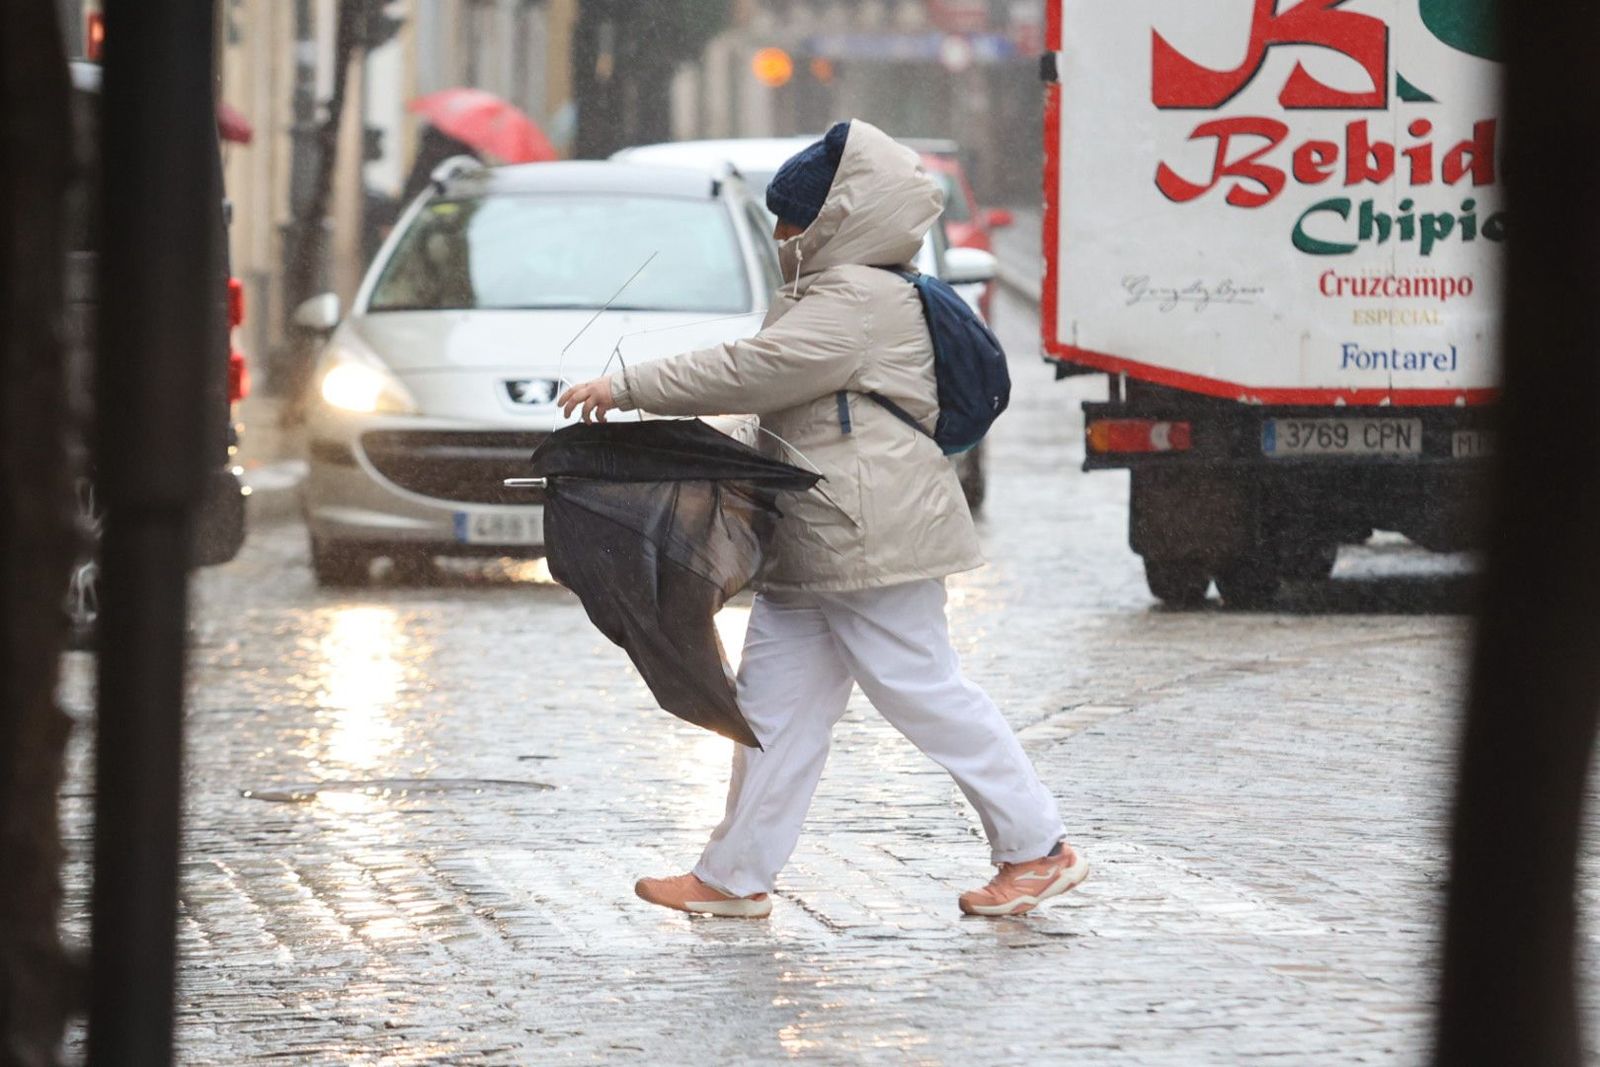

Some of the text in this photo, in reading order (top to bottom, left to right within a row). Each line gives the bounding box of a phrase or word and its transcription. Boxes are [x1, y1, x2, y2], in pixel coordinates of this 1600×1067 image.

[1155, 116, 1497, 208] Bebid
[1319, 268, 1474, 302] Cruzcampo
[1352, 308, 1443, 327] ESPECIAL
[1340, 342, 1458, 371] Fontarel
[1286, 422, 1412, 449] 3769 CPN
